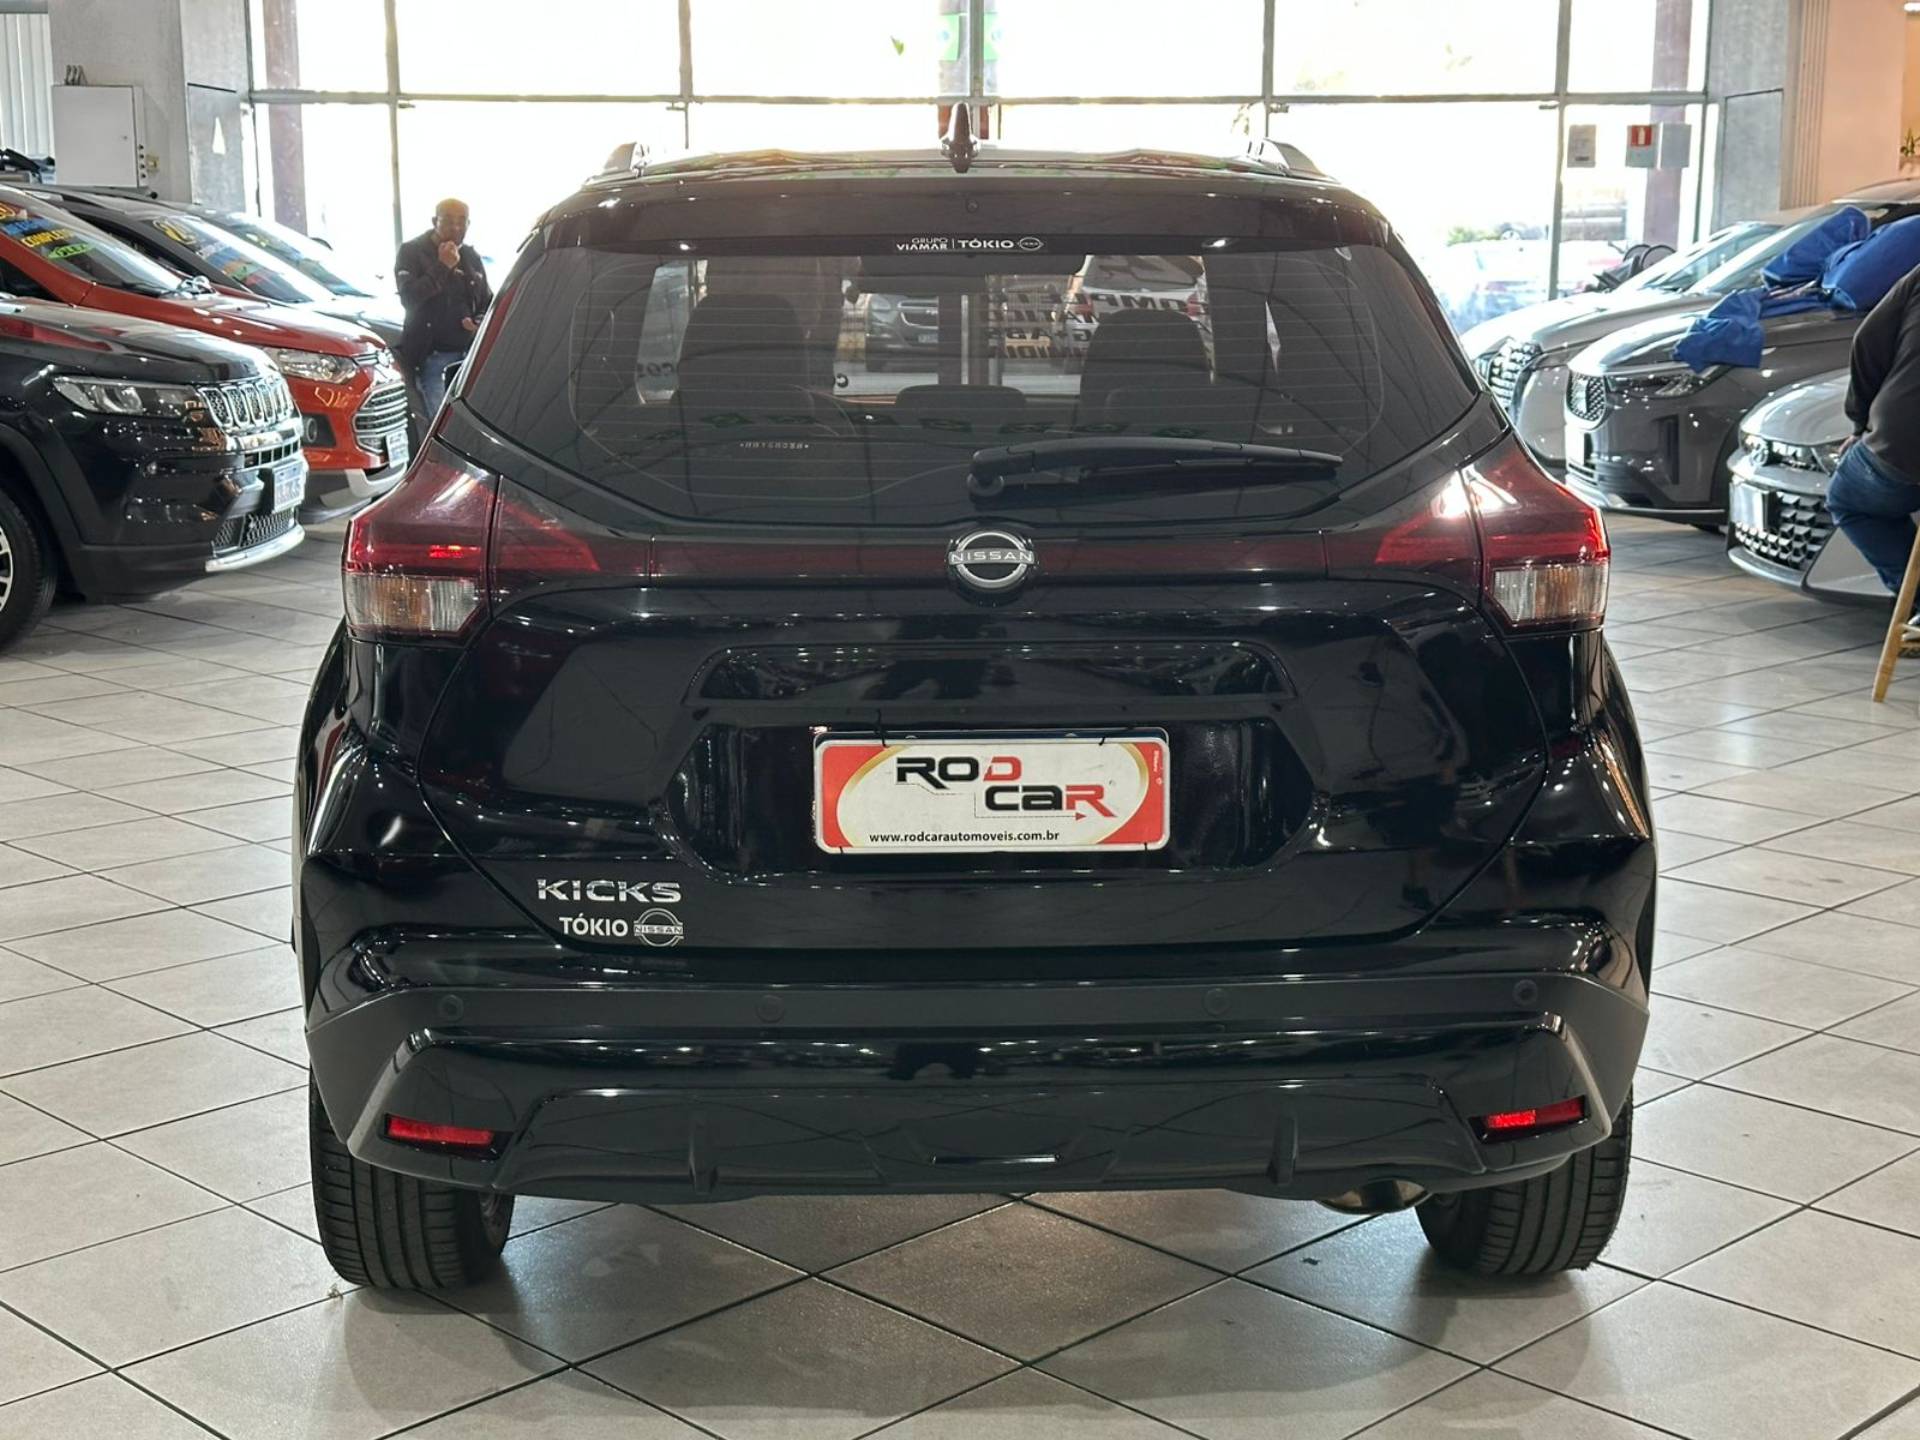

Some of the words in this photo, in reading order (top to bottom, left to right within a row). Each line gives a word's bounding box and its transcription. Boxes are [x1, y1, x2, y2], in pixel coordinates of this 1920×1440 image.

[911, 236, 949, 244] GRUPO
[957, 237, 1015, 249] TÓKIO
[896, 243, 948, 251] VIAMAR
[950, 550, 1033, 563] NISSAN
[896, 756, 1022, 789] ROD
[869, 830, 1060, 843] www.rodcarautomoveis.com.br
[536, 879, 682, 904] KICKS
[558, 912, 629, 938] TÓKIO
[634, 925, 684, 936] NISSAN
